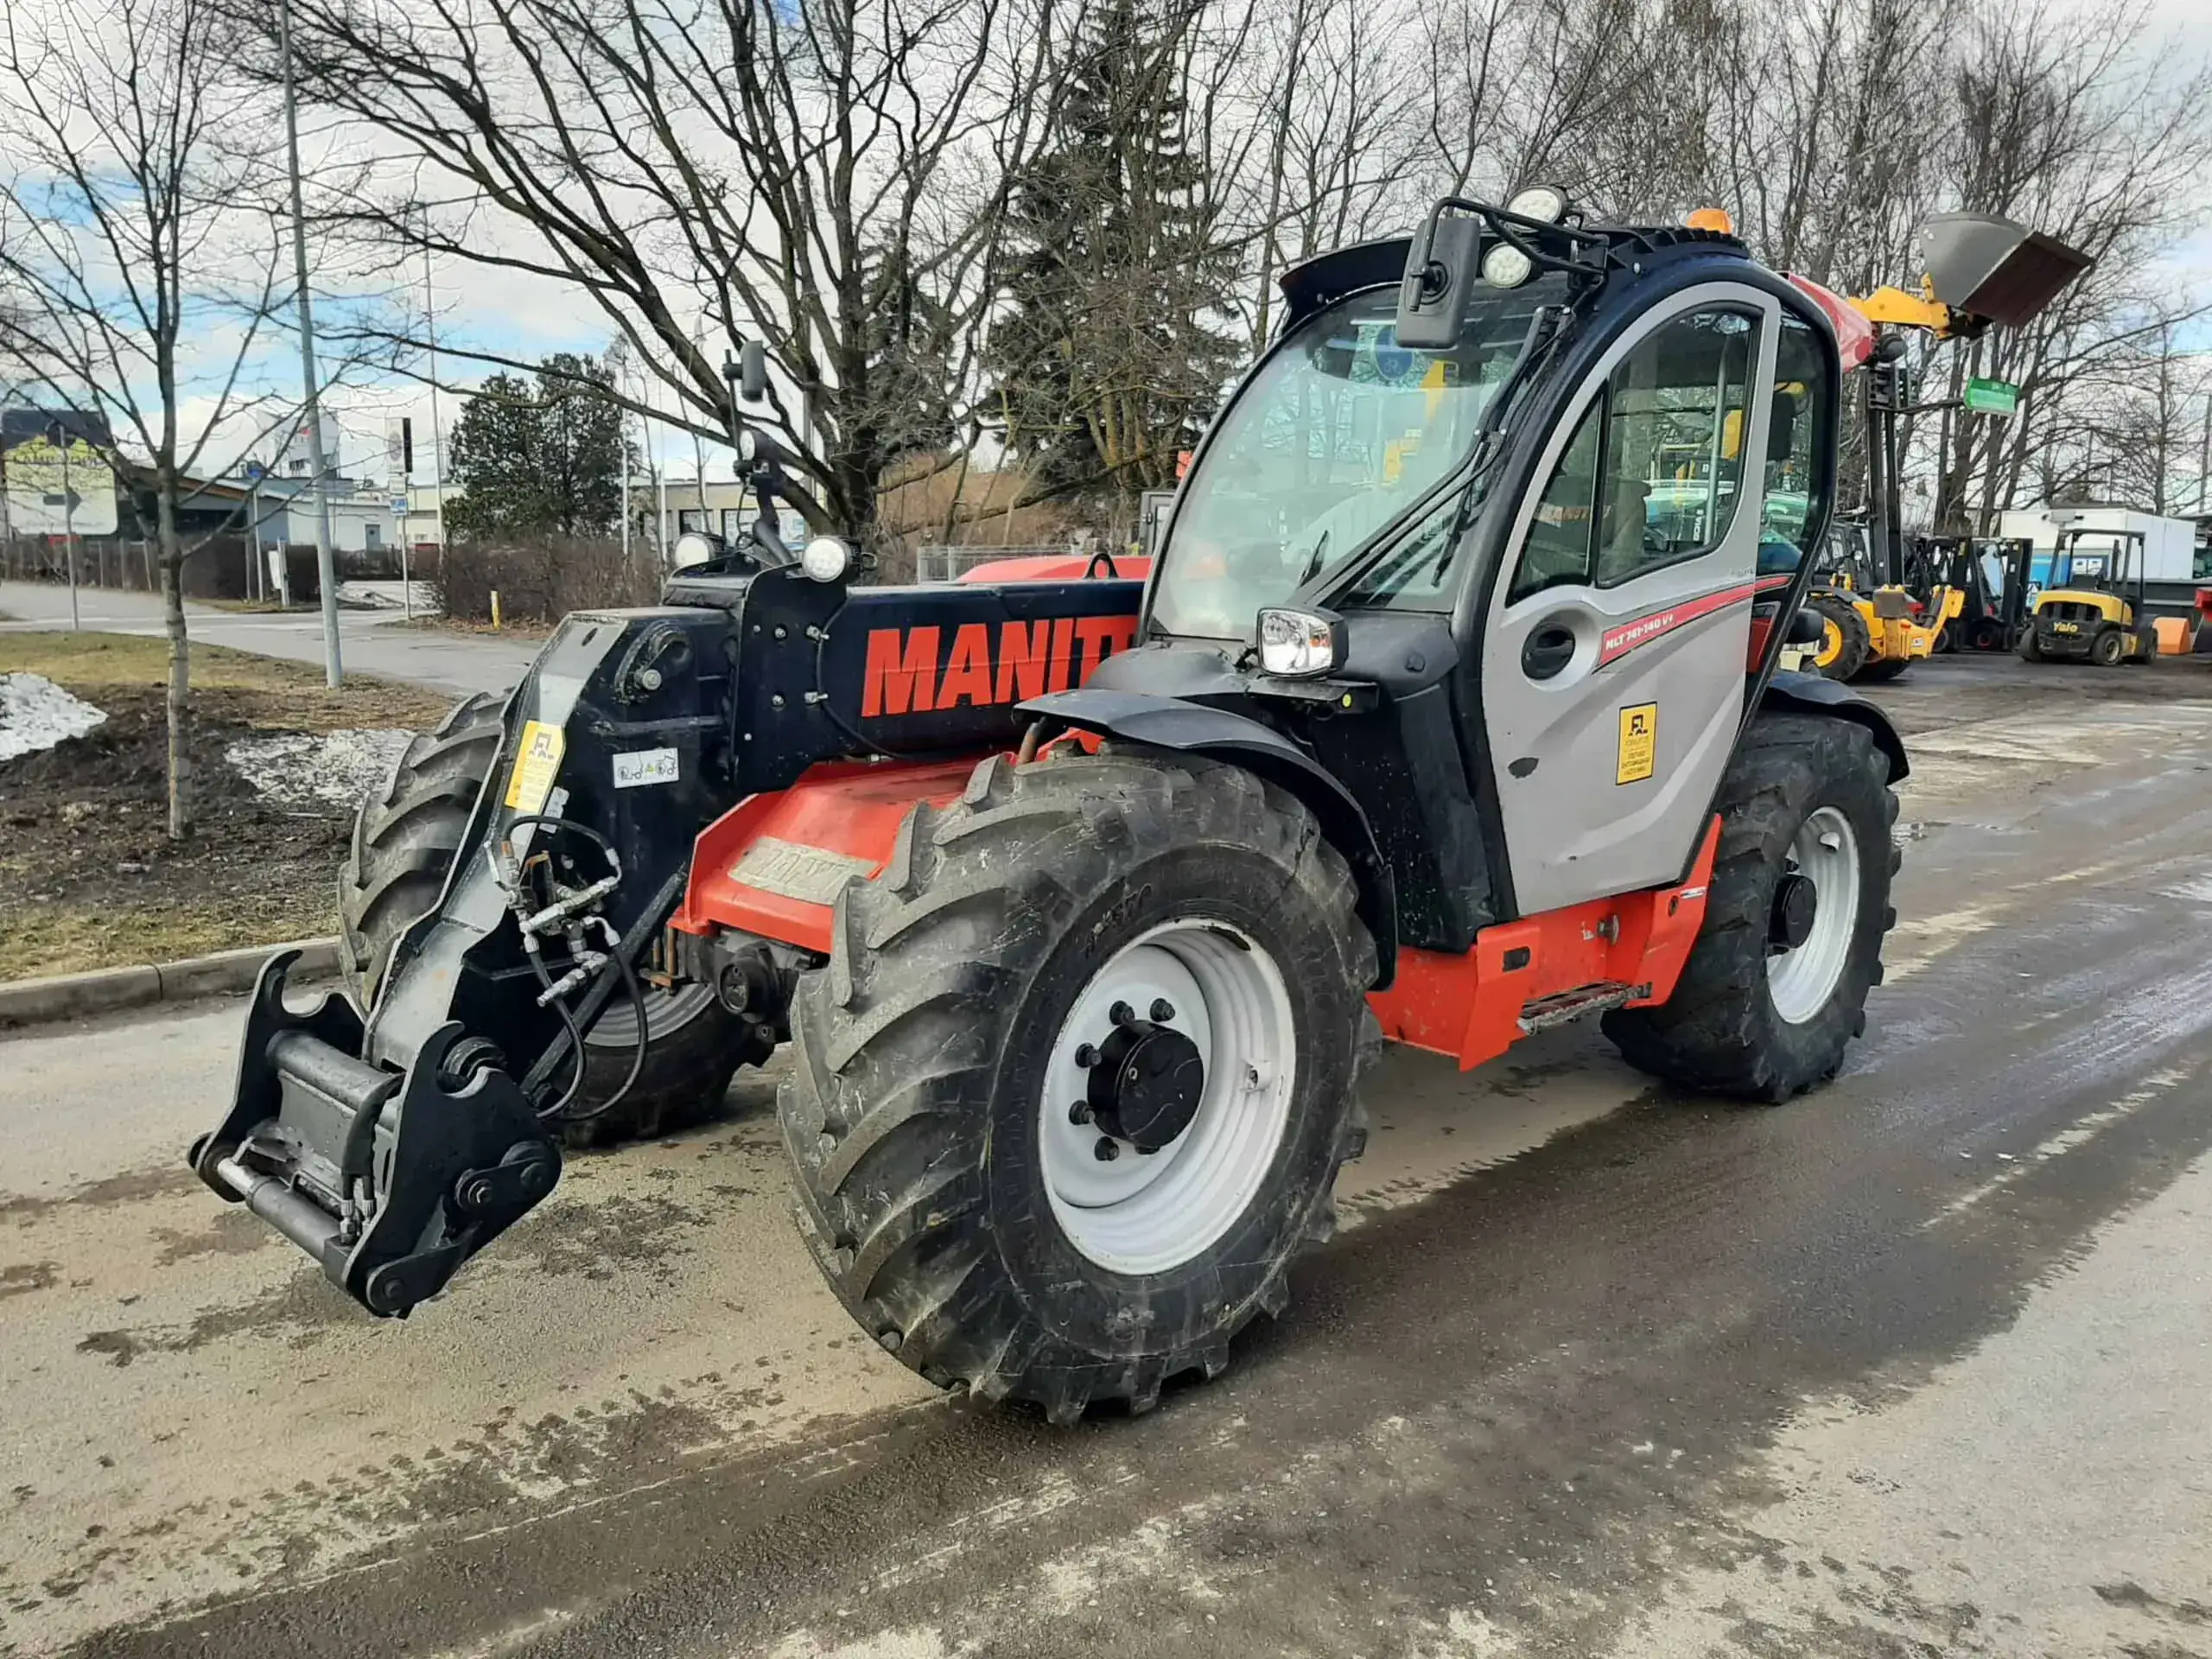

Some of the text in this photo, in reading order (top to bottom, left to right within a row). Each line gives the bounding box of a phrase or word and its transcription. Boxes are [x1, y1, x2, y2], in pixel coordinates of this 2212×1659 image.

[861, 615, 1139, 717] MANIT
[1605, 633, 1625, 650] MLT
[1626, 618, 1661, 642] 741-140
